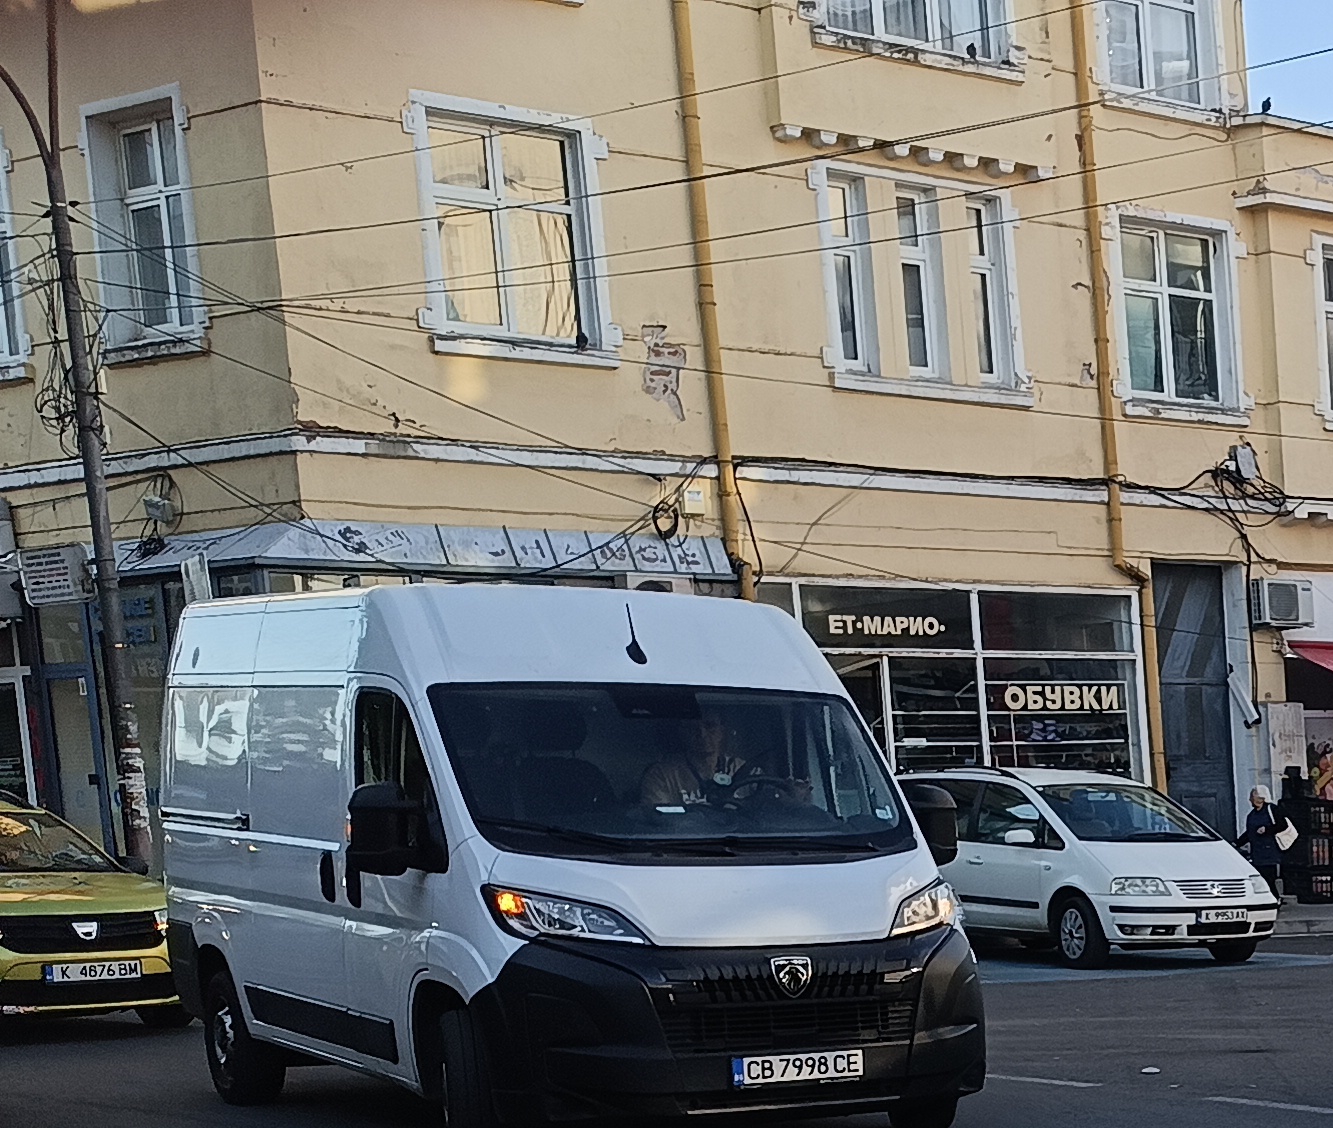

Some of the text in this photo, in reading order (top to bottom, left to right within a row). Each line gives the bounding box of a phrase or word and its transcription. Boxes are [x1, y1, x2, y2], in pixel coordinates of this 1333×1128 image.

[1004, 685, 1119, 710] ОБУВКИ
[60, 965, 71, 980] K
[747, 1052, 860, 1080] CB 7998 CE
